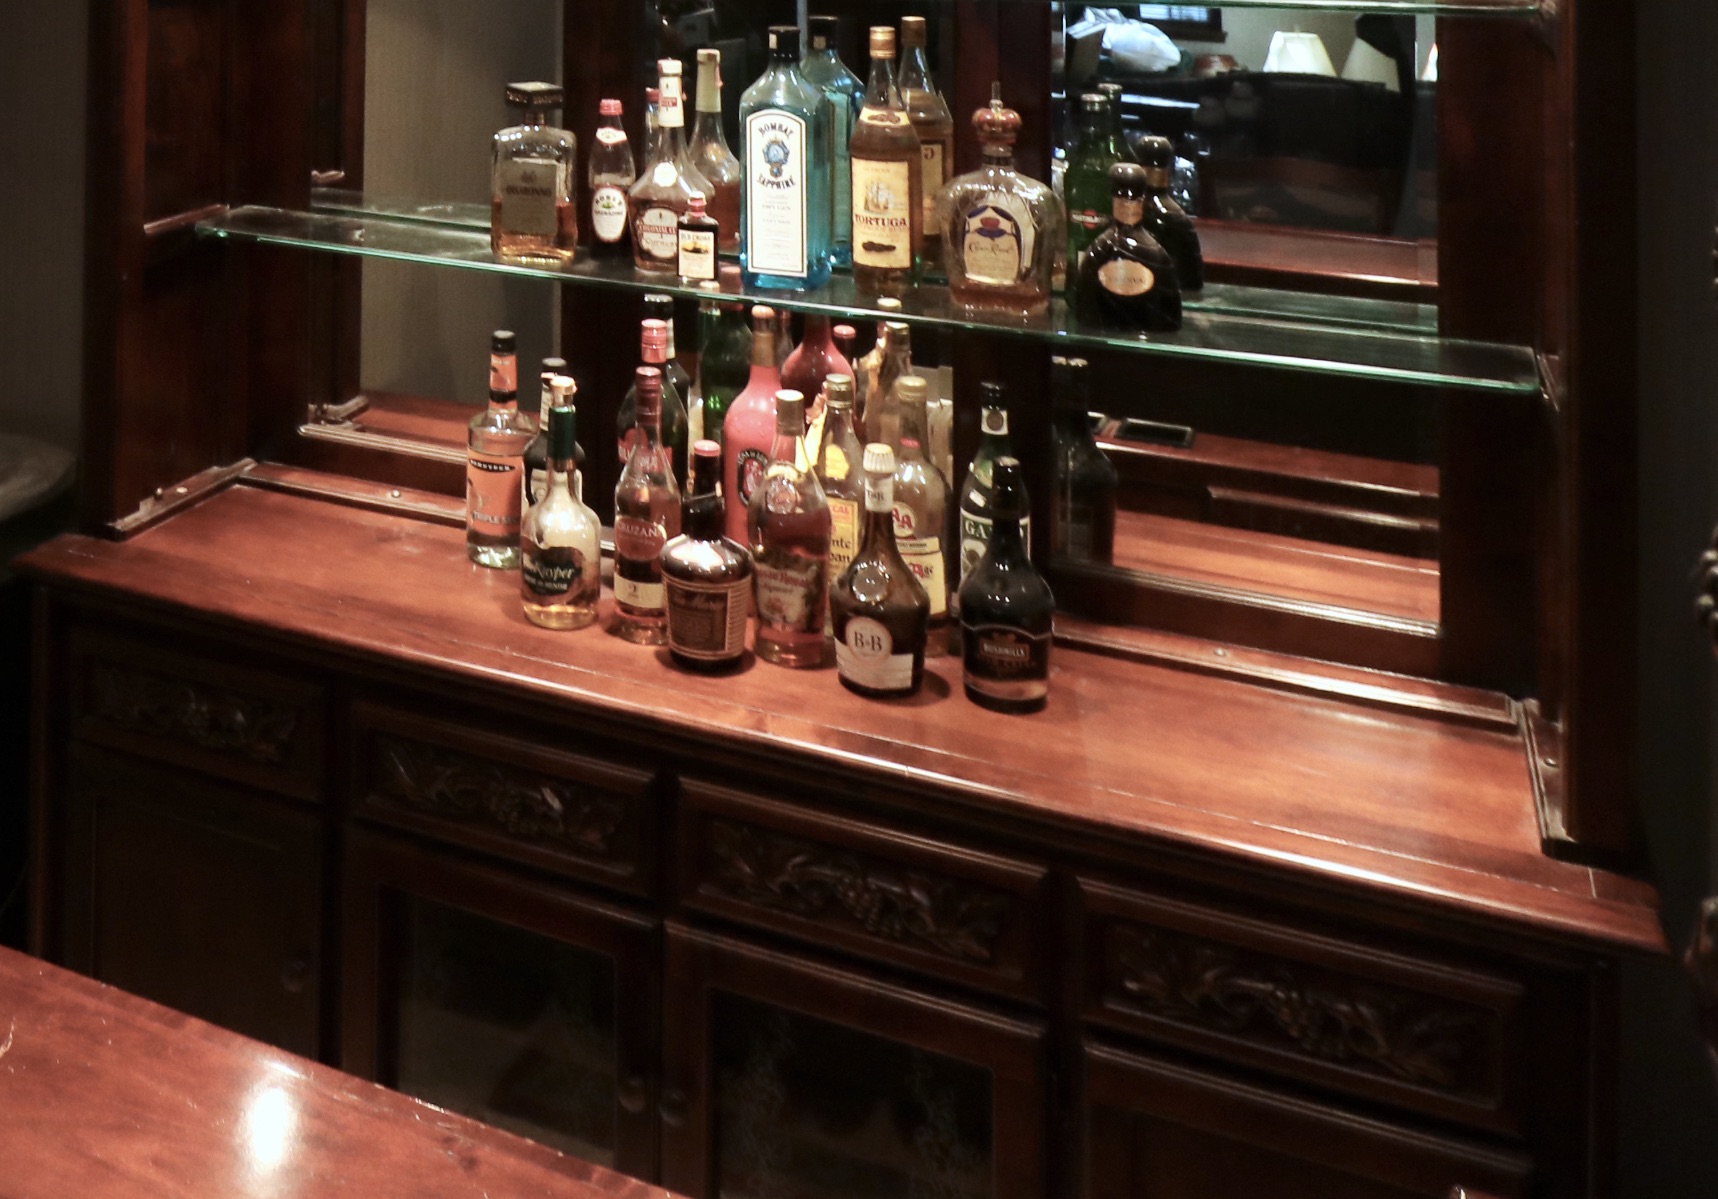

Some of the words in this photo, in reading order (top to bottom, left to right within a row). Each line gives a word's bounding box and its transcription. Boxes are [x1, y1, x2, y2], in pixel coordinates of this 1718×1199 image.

[758, 122, 795, 139] BOMBAY
[756, 173, 797, 190] SAPPHIRE
[854, 213, 908, 227] TORTUGA
[831, 504, 850, 514] CAL
[831, 537, 851, 550] nte
[830, 551, 851, 563] ban
